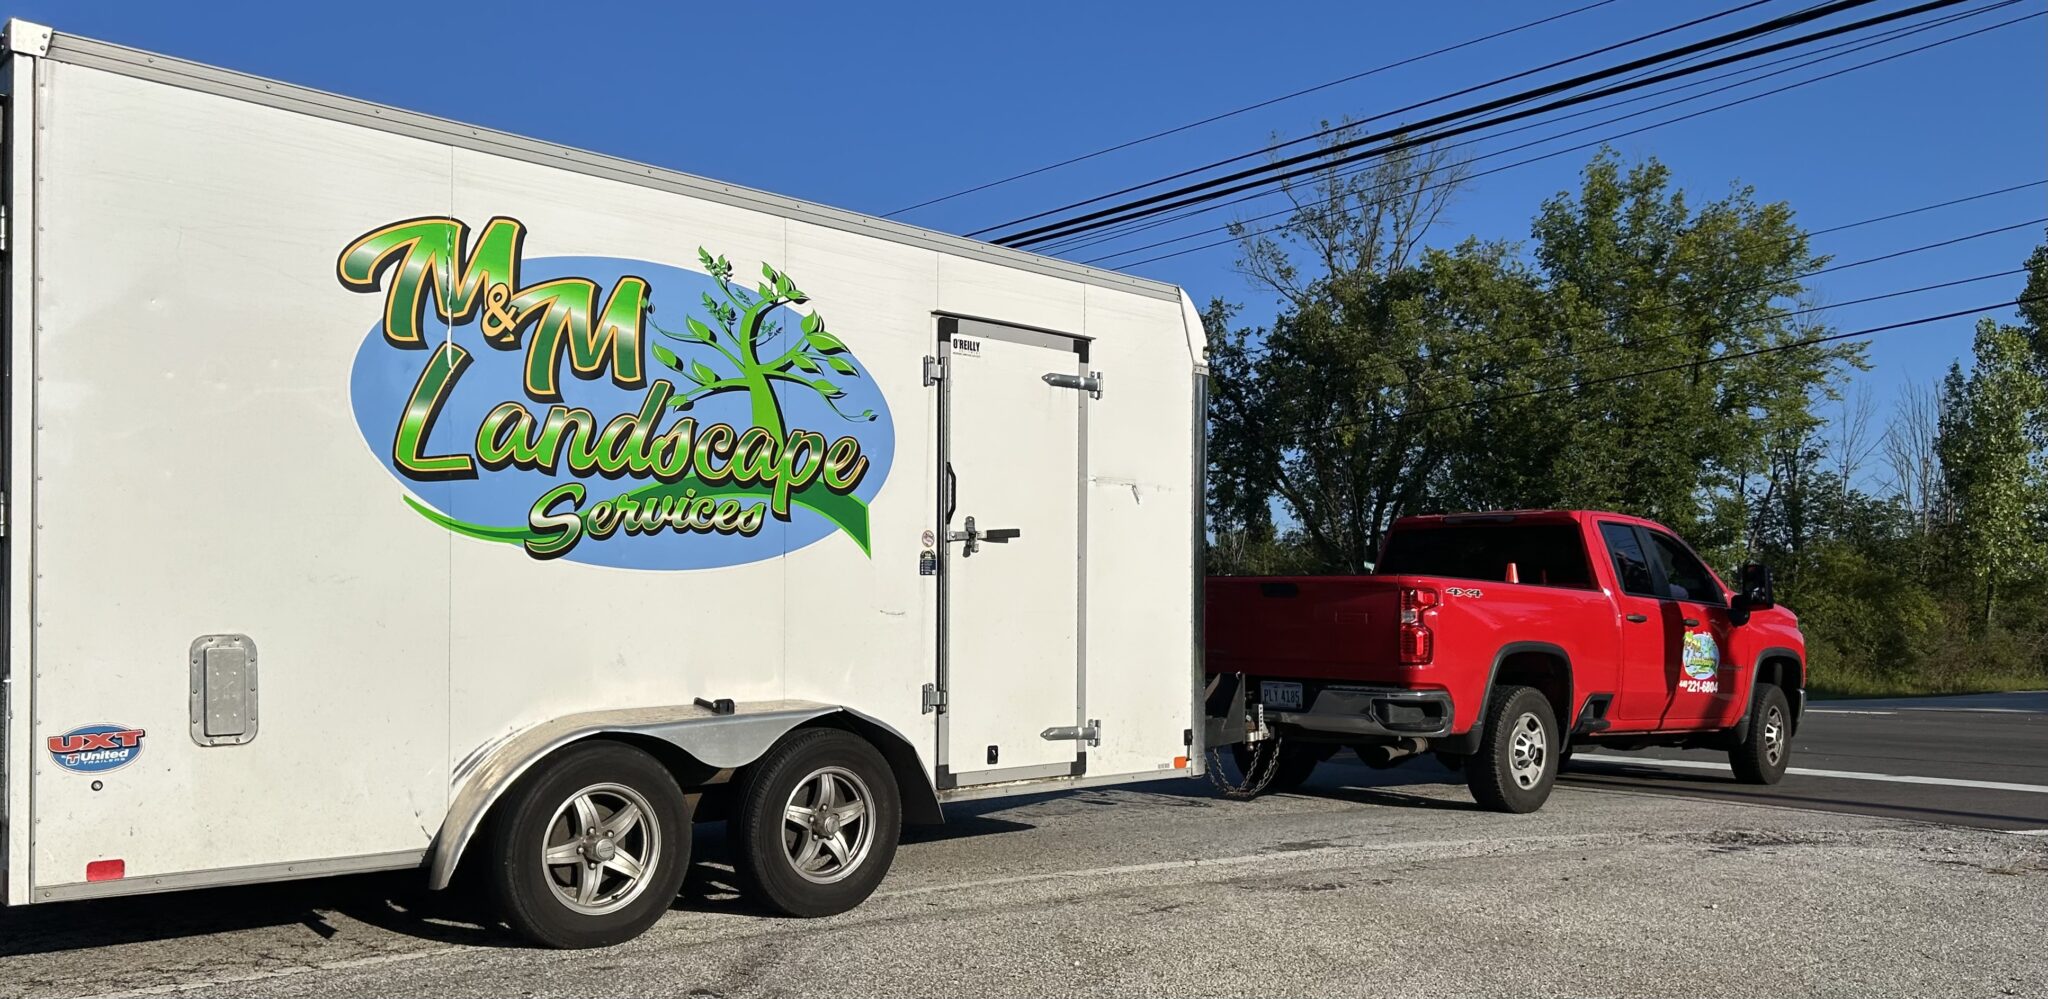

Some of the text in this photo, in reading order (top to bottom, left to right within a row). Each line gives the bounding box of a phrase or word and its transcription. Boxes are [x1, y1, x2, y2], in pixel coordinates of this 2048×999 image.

[953, 338, 980, 352] O'REILLY
[393, 344, 869, 522] Landscape
[524, 483, 766, 561] Services
[1264, 688, 1299, 703] PLY 4185
[48, 729, 145, 753] UXT
[81, 749, 130, 761] United
